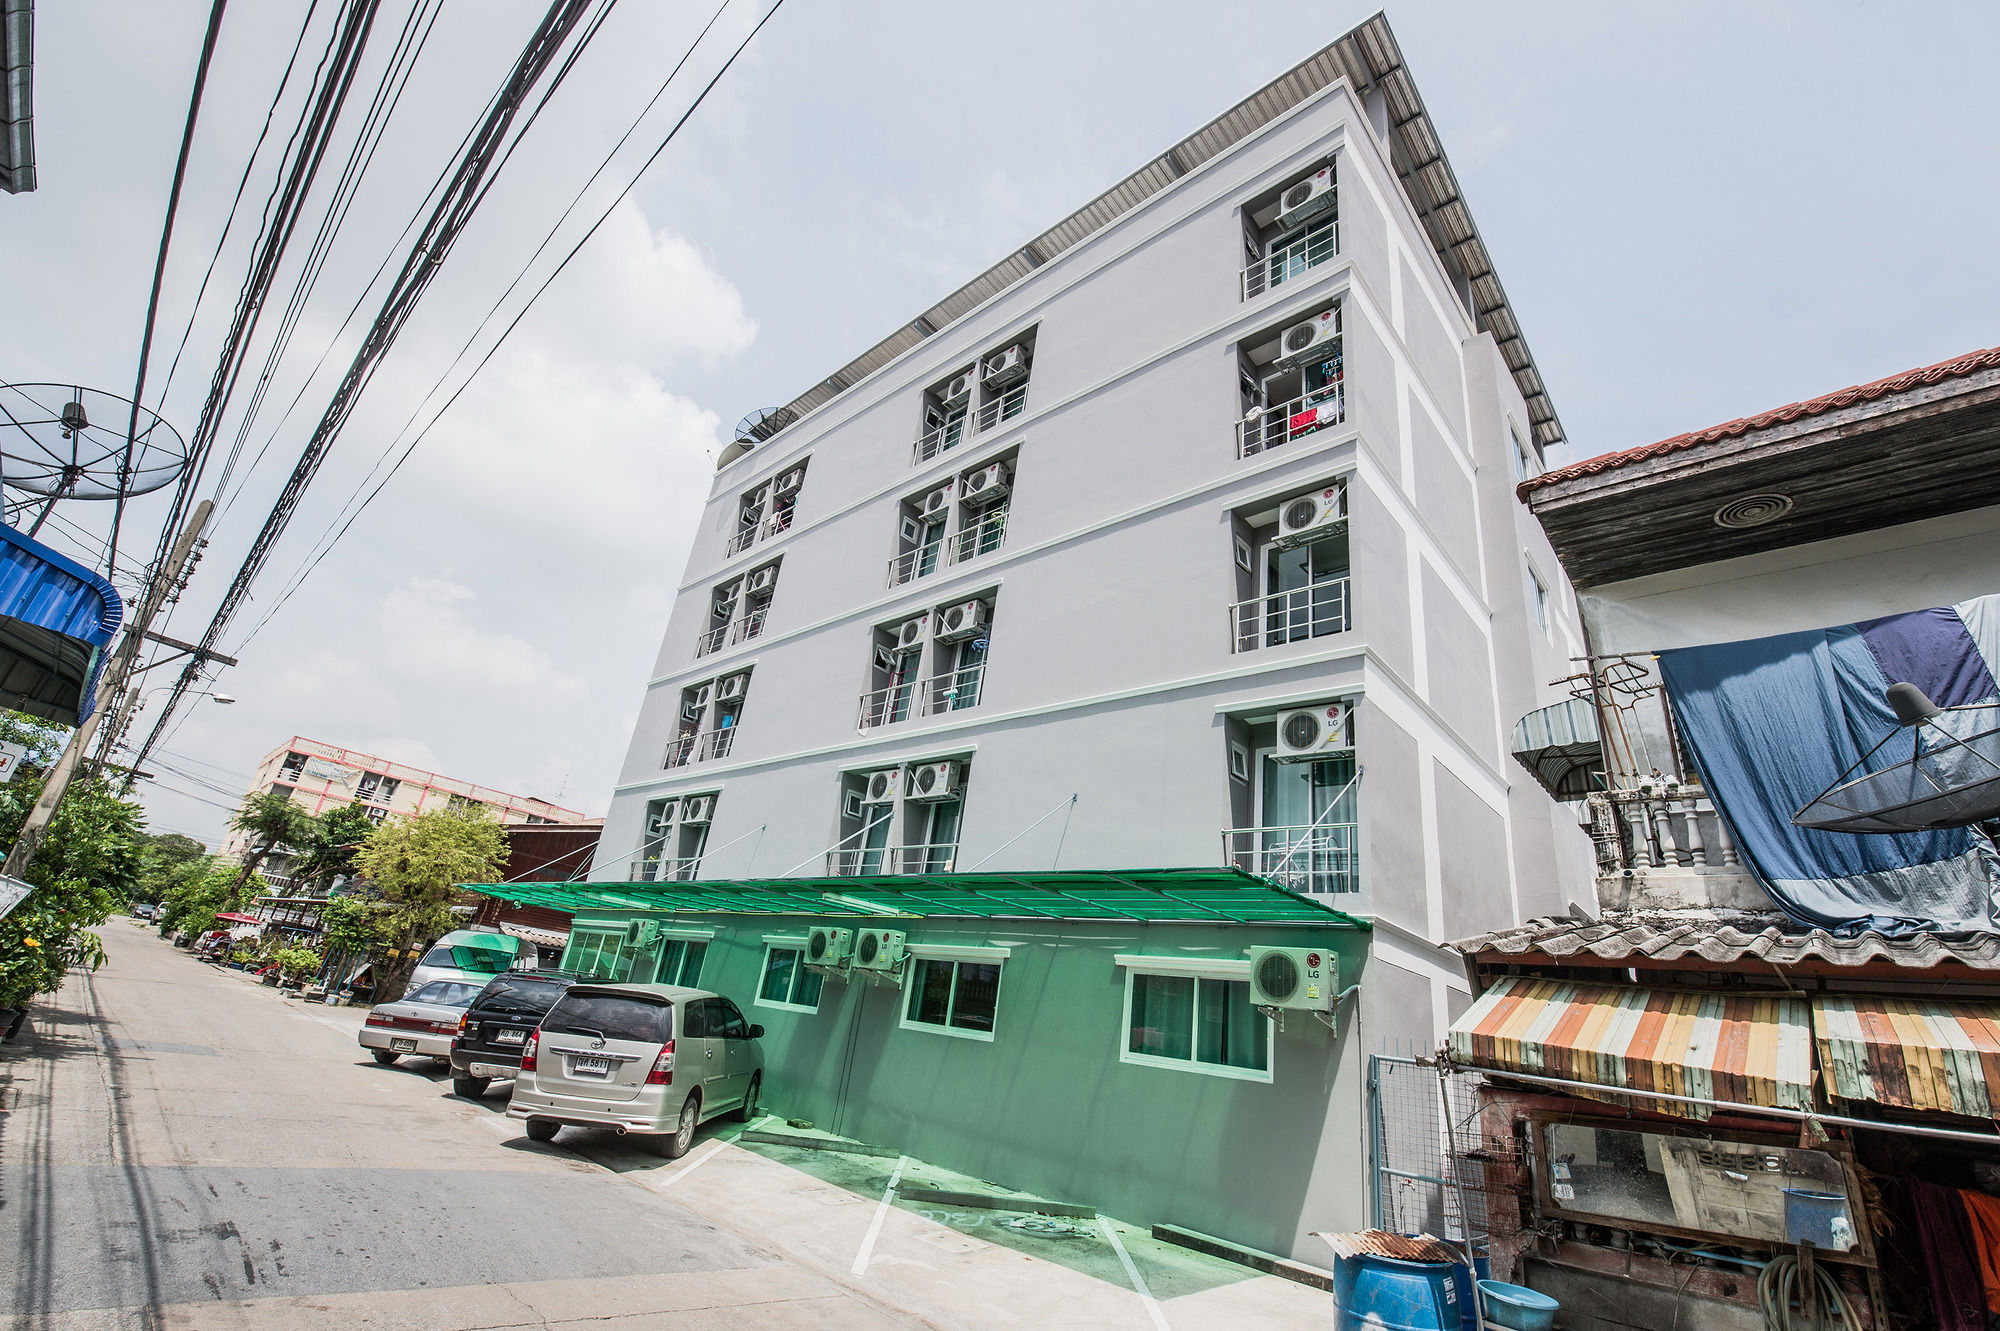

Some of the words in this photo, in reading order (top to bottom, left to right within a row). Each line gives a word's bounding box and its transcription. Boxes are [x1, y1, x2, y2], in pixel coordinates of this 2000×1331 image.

[1328, 719, 1338, 727] LG
[1308, 970, 1320, 978] LG
[590, 1058, 608, 1069] 5811
